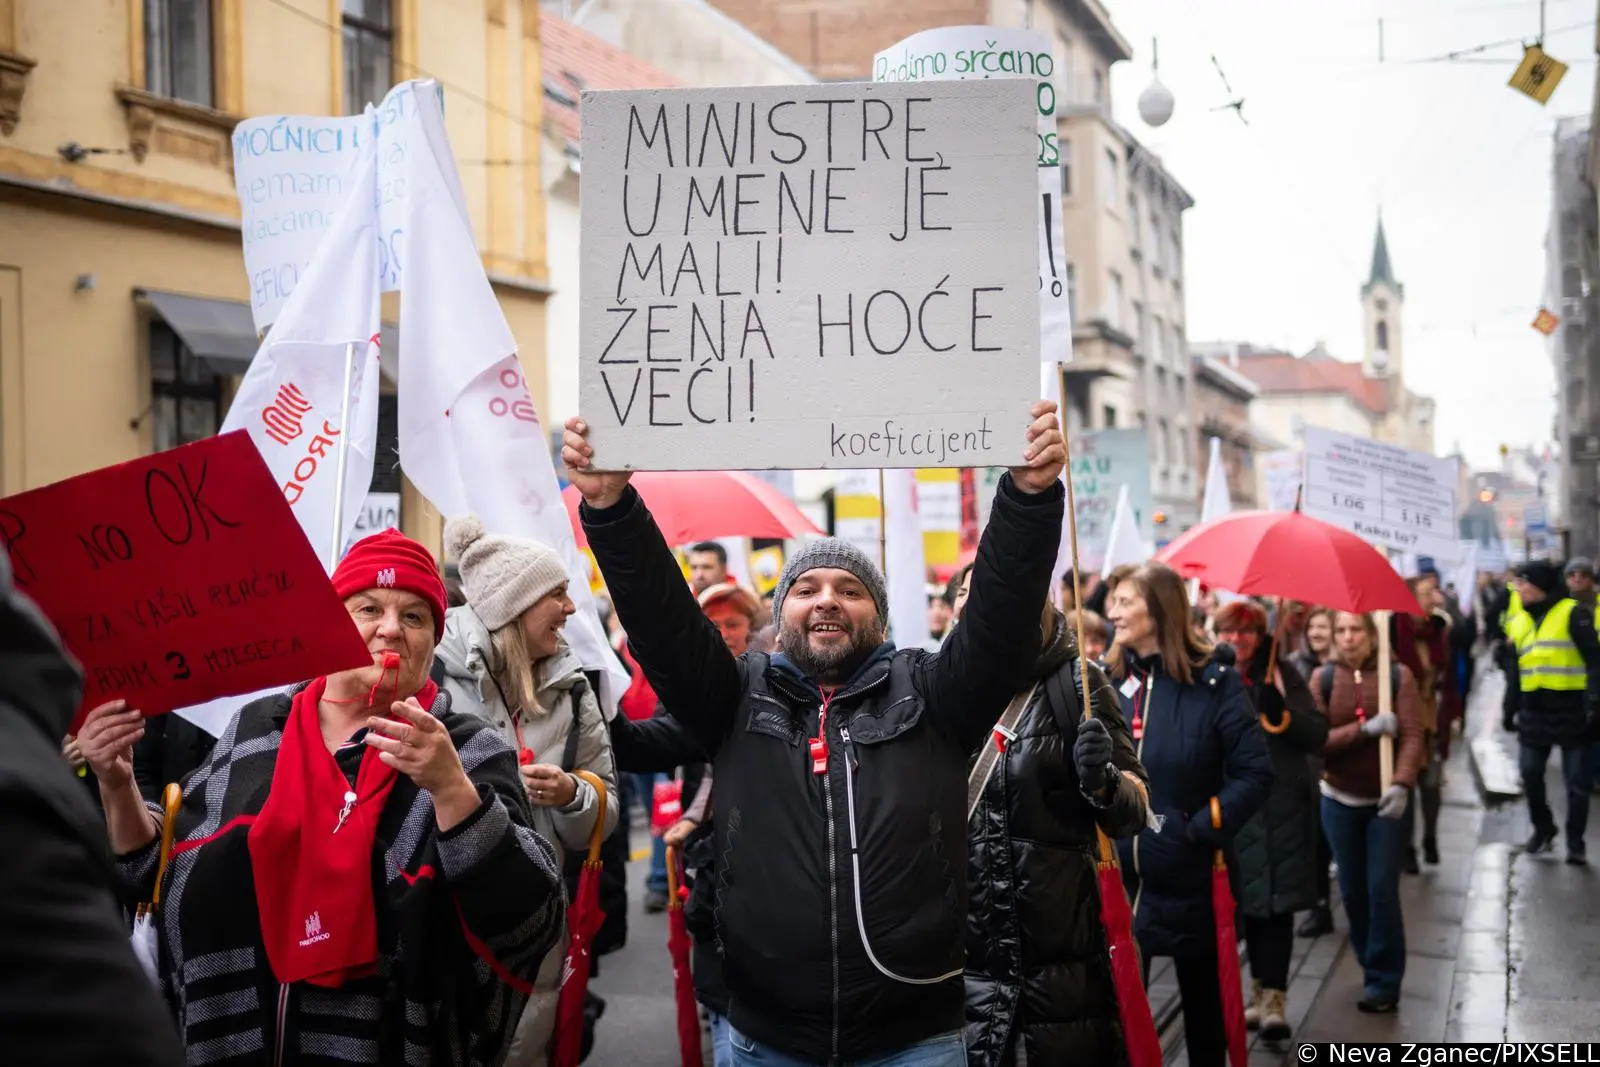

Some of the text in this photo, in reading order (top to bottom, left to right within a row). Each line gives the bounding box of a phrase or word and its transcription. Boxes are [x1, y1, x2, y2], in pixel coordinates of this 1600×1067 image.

[954, 40, 1054, 77] srčano
[624, 97, 944, 170] MINISTRE,
[623, 166, 952, 241] U MENE JE
[617, 236, 784, 298] MALI!
[599, 275, 1004, 364] ŽENA HOĆE
[600, 357, 756, 426] VEĆI!
[830, 417, 993, 463] koeficijent
[76, 524, 133, 570] NO
[144, 456, 241, 546] OK
[92, 637, 306, 696] ADIM 3 MJESECA
